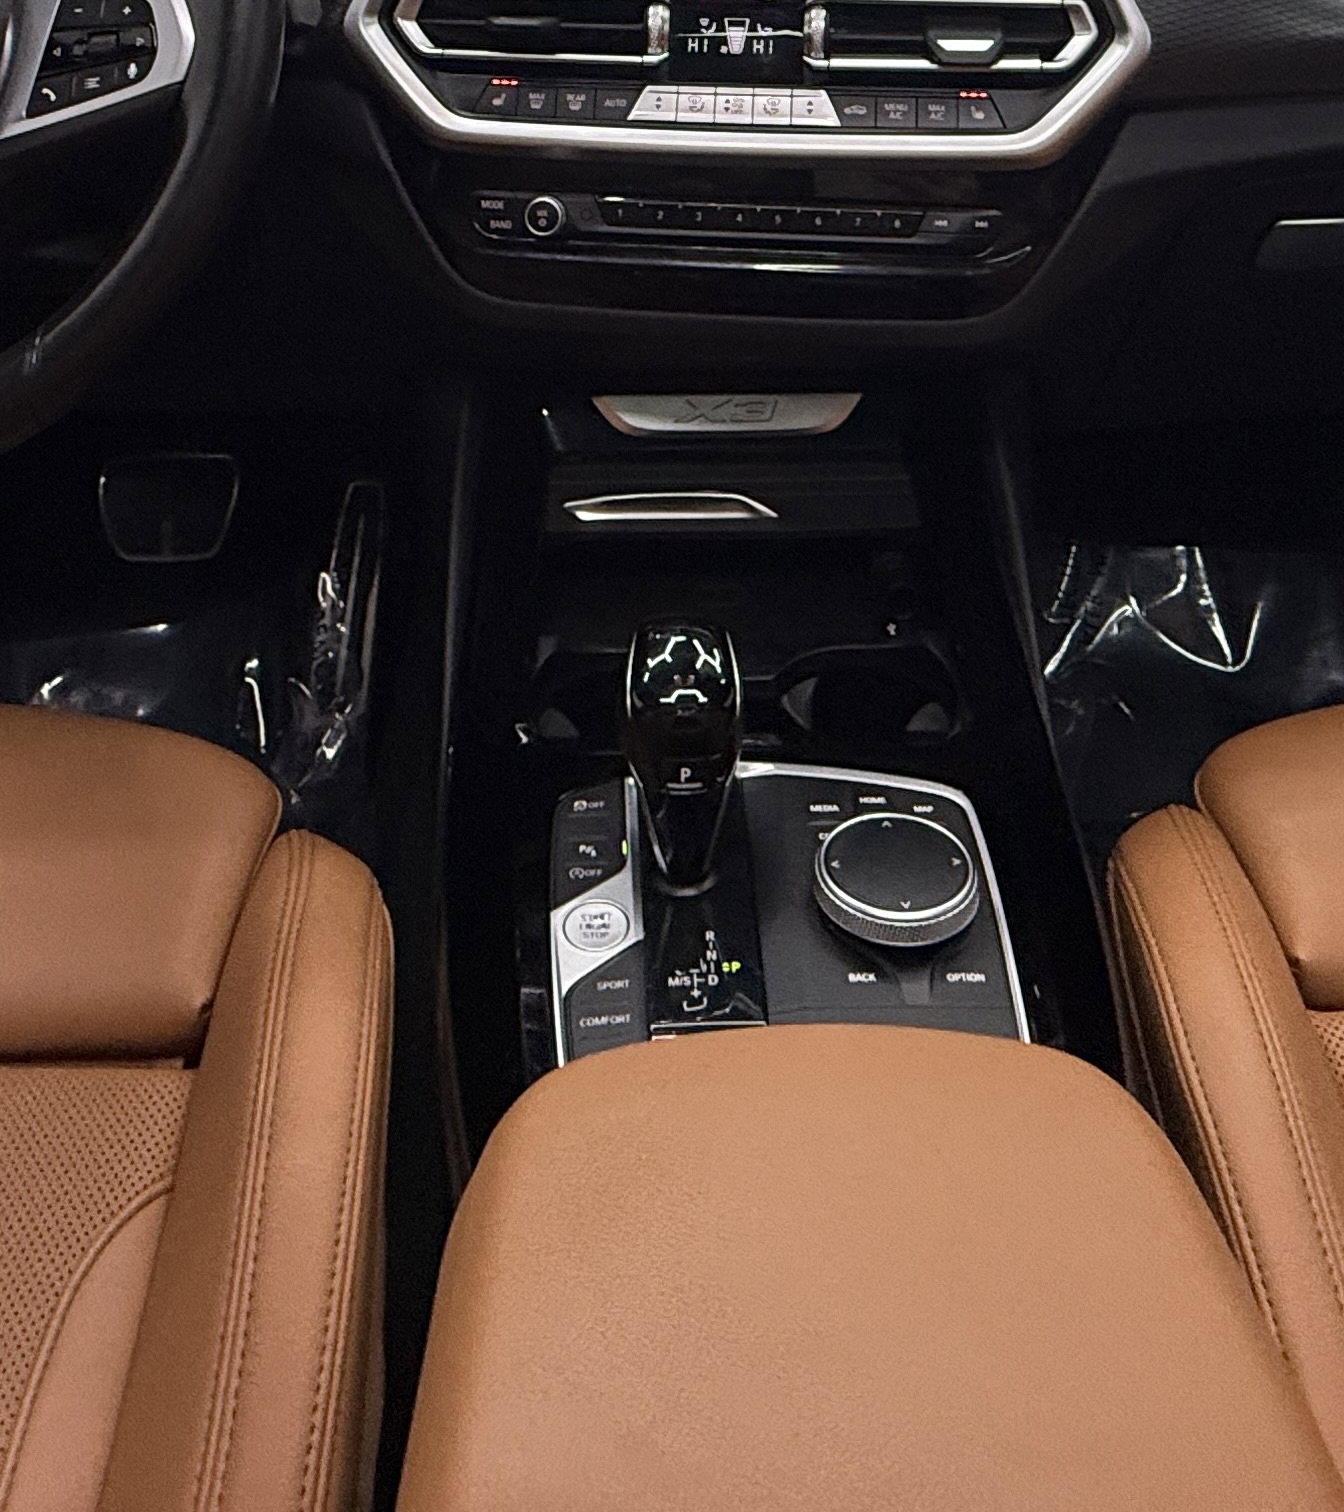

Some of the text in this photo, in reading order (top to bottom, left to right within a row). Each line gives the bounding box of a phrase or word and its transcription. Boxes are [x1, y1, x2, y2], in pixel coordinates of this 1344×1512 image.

[688, 38, 709, 54] HI
[753, 39, 773, 55] HI
[565, 92, 586, 102] REAR
[480, 199, 505, 211] MODE
[489, 219, 513, 230] BAND
[674, 398, 778, 424] X3
[680, 768, 691, 782] P
[588, 800, 605, 809] OFF
[859, 796, 887, 805] HOME
[810, 804, 840, 813] MEDIA
[912, 805, 934, 814] MAP
[584, 868, 603, 877] OFF
[582, 931, 610, 939] STOP
[705, 931, 715, 941] R
[706, 950, 716, 961] N
[668, 976, 691, 988] M/S
[708, 975, 719, 986] D
[848, 972, 877, 983] BACK
[946, 972, 986, 983] OPTION
[597, 979, 630, 990] SPORT
[579, 1013, 631, 1028] COMFORT
